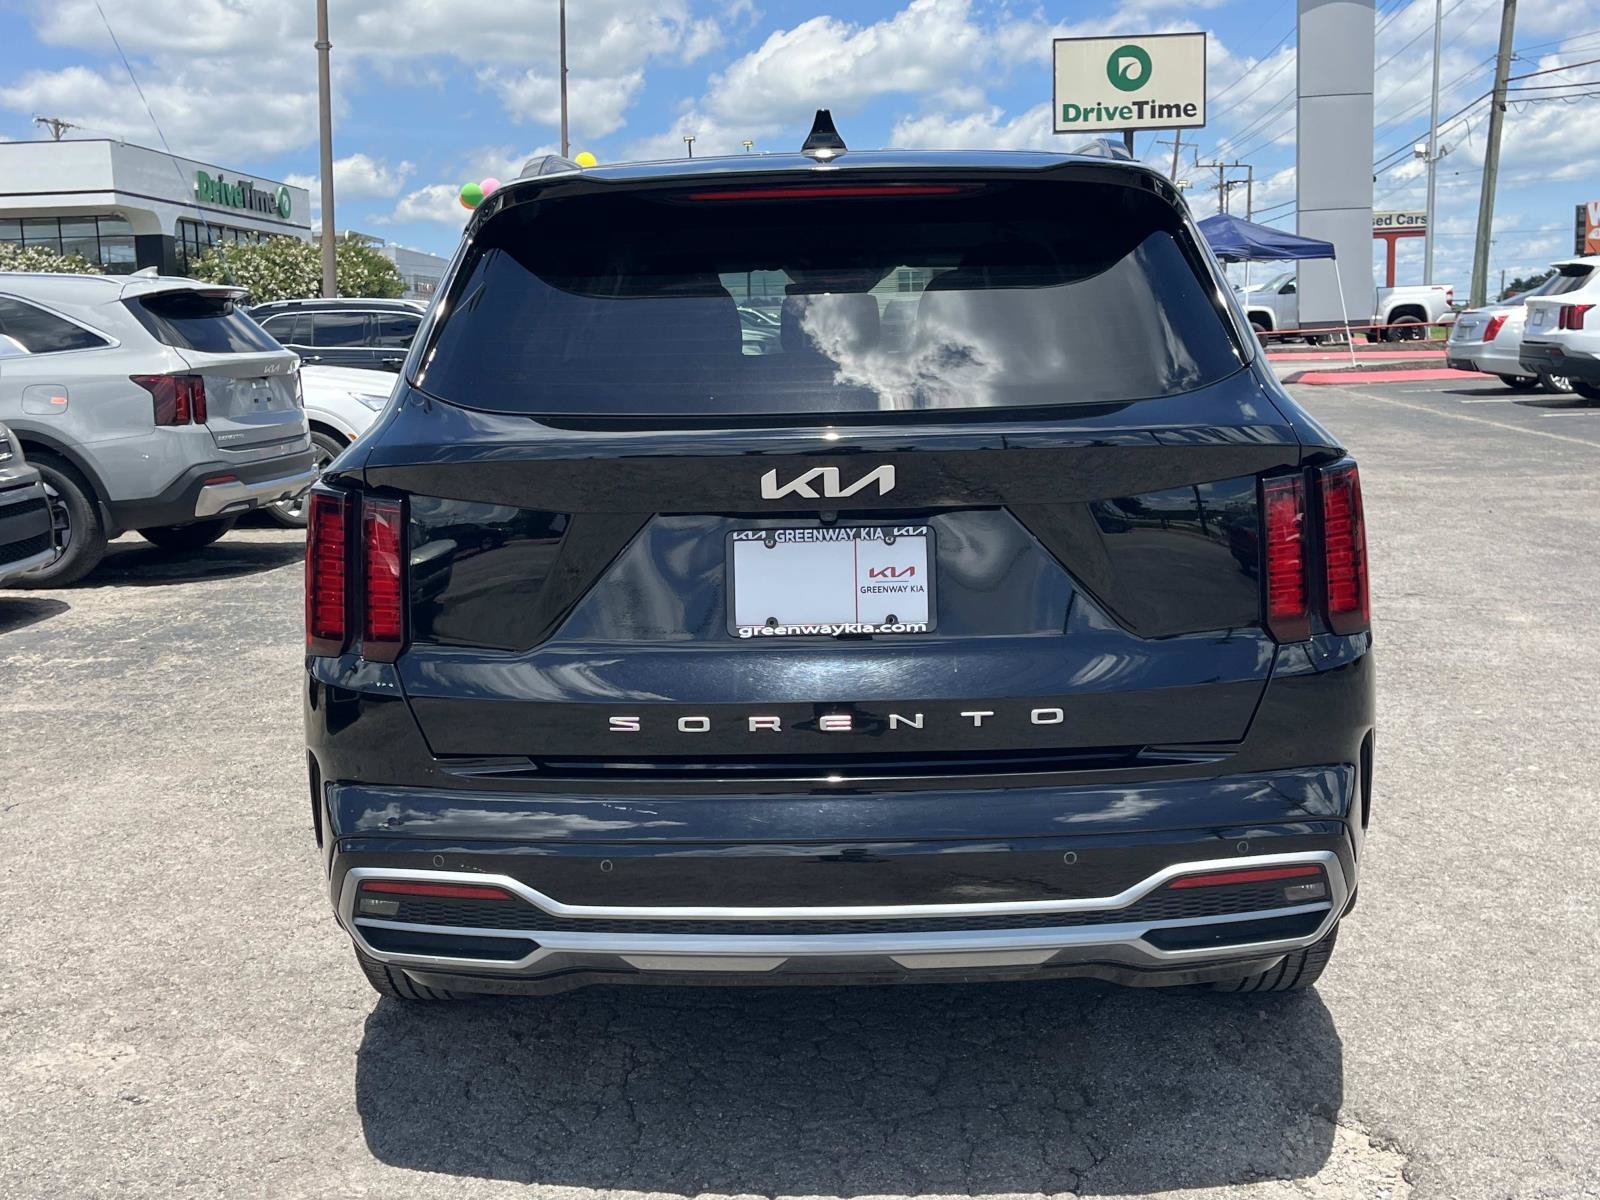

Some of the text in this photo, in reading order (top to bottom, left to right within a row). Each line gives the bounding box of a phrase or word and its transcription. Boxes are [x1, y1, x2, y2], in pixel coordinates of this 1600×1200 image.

[1062, 99, 1197, 122] DriveTime
[195, 170, 277, 214] DriveTime
[1396, 213, 1428, 225] Cars
[761, 465, 896, 500] KIA
[733, 531, 767, 540] KIA
[774, 528, 885, 543] GREENWAY KIA
[894, 526, 927, 537] KIA
[868, 566, 915, 578] KIA
[860, 585, 925, 594] GREENWAY KIA
[738, 622, 927, 638] greenwaykia.com
[609, 707, 1065, 732] SORENTO
